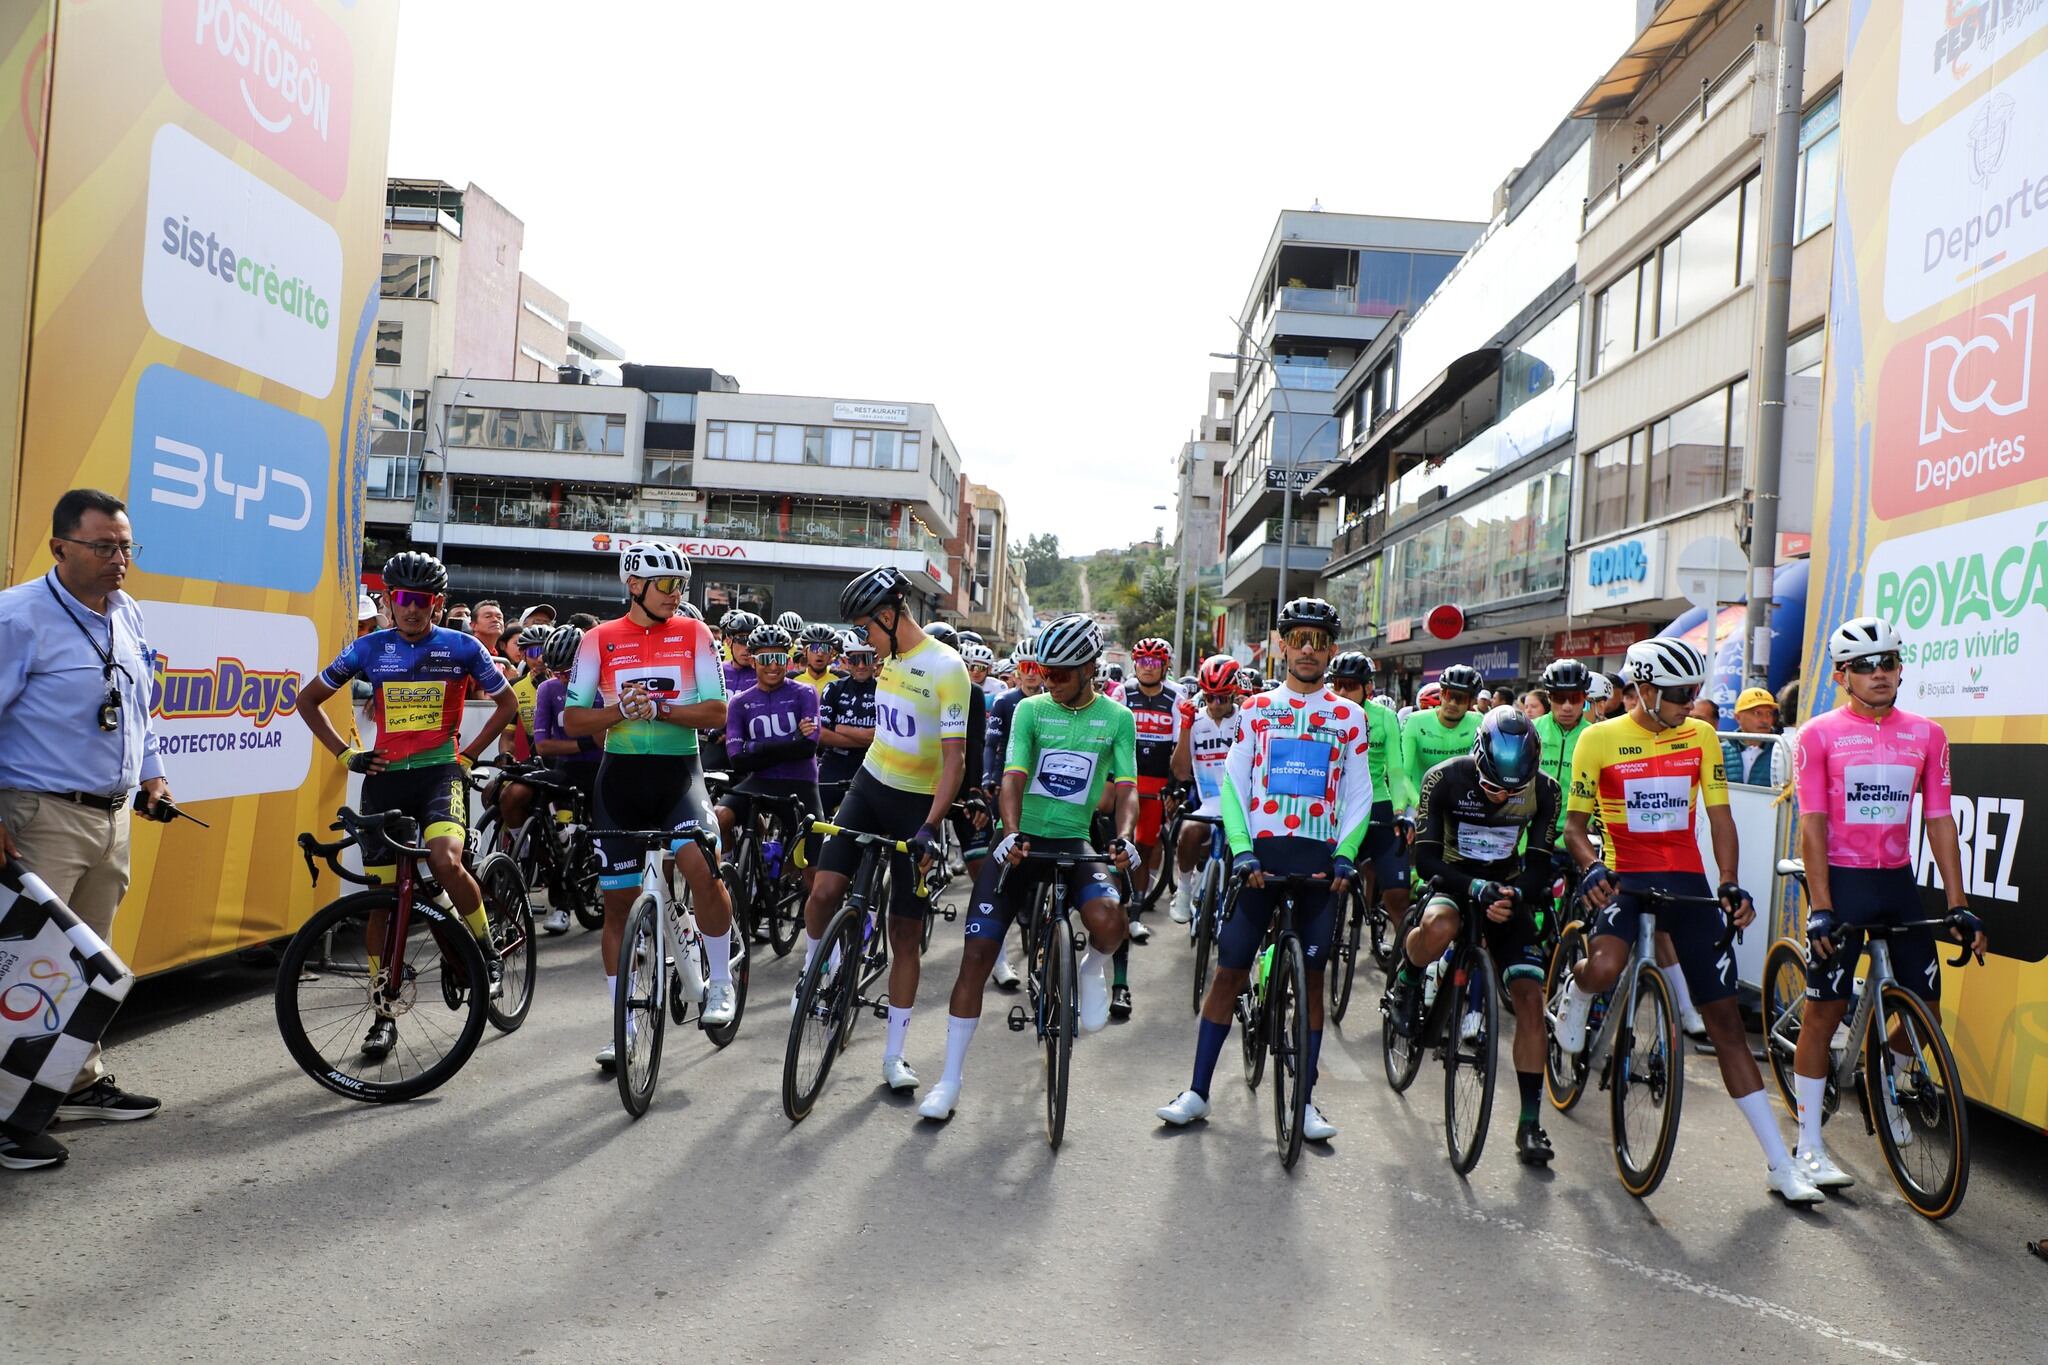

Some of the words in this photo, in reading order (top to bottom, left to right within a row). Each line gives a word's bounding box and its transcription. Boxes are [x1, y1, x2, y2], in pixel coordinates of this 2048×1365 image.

[249, 0, 302, 50] NZANA
[162, 215, 329, 330] sistecrédito
[854, 407, 906, 416] RESTAURANTE
[1915, 435, 2026, 492] Deportes
[151, 436, 313, 531] BYD
[619, 539, 746, 558] DIENDA
[624, 553, 640, 571] 86
[877, 571, 893, 586] 1
[1900, 646, 1917, 664] es
[1921, 638, 1958, 669] para
[1965, 628, 2020, 657] vivirla
[1472, 646, 1508, 676] croydon
[748, 711, 798, 740] nu
[876, 703, 917, 738] nu
[158, 733, 236, 755] ROTECTOR
[239, 731, 282, 749] SOLAR
[1194, 737, 1233, 751] HIN
[1619, 746, 1642, 755] IDRD
[1271, 765, 1326, 778] sistecrédito
[1286, 760, 1306, 768] team
[1614, 762, 1649, 770] GANADOR
[1418, 770, 1444, 820] MacPollo
[1854, 782, 1890, 793] Team
[1627, 796, 1689, 809] Medellín
[1633, 791, 1669, 801] Team
[1847, 790, 1910, 802] Medellín
[1641, 811, 1677, 824] epm
[1860, 805, 1897, 819] epm
[674, 819, 700, 832] SUAREZ
[1909, 792, 2025, 903] AREZ
[613, 858, 638, 871] SUAREZ
[412, 902, 447, 921] MAVIC
[327, 1070, 365, 1091] MAVIC
